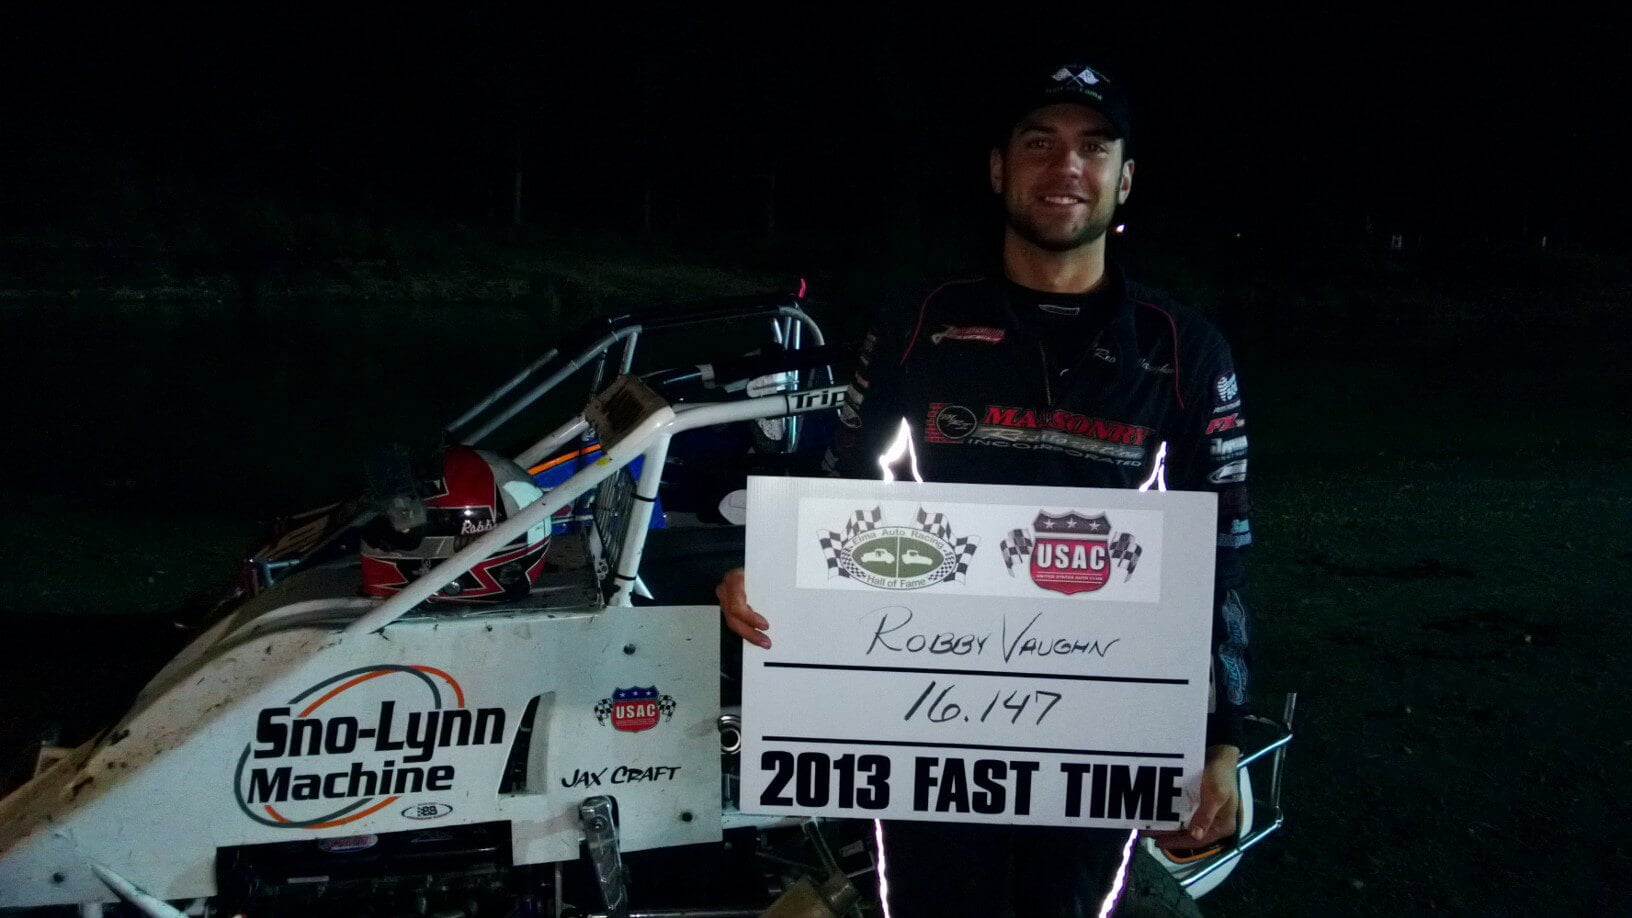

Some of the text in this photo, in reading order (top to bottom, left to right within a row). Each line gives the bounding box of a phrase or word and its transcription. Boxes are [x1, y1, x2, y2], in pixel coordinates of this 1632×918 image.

[982, 405, 1148, 445] MASONRY
[968, 439, 1142, 467] INCORPORATED
[461, 519, 494, 535] Robb
[853, 532, 876, 545] Elma
[911, 530, 945, 549] Racing
[1037, 544, 1105, 570] USAC
[867, 575, 926, 588] Hall of Fame
[862, 606, 1120, 663] ROBBY VAUGHN
[616, 704, 656, 719] USAC
[904, 681, 1062, 725] 16.147
[254, 700, 506, 763] Sno-Lynn
[247, 760, 455, 804] Machine
[561, 766, 682, 789] JAX CRAFT
[759, 750, 1185, 822] 2013 FAST TIME
